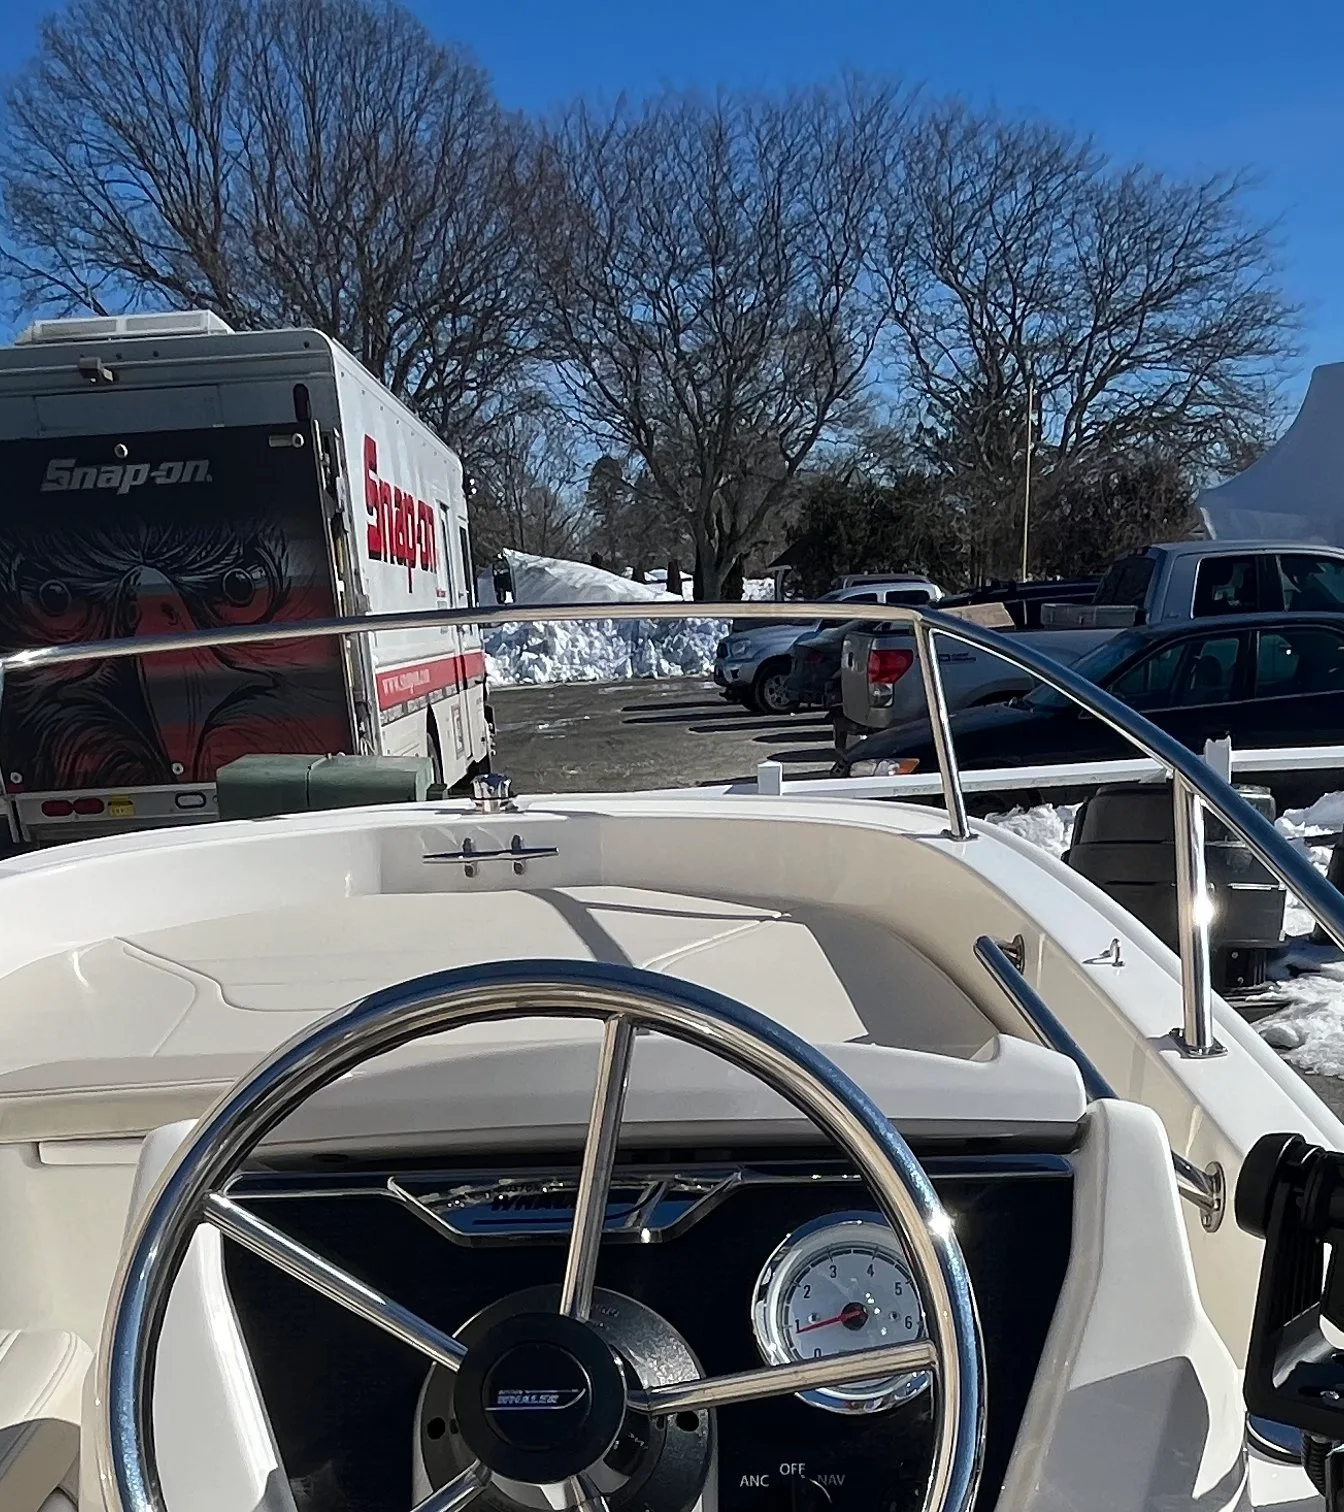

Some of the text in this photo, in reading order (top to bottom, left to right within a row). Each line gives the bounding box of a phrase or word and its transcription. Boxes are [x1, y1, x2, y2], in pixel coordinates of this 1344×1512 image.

[364, 433, 438, 593] Snap-on
[829, 1264, 837, 1279] 3
[866, 1263, 875, 1278] 4
[803, 1284, 811, 1299] 2
[894, 1282, 903, 1296] 5
[794, 1319, 801, 1332] 1
[904, 1315, 913, 1330] 6
[779, 1462, 806, 1476] OFF
[739, 1474, 770, 1488] ANC
[816, 1473, 846, 1487] NAV
